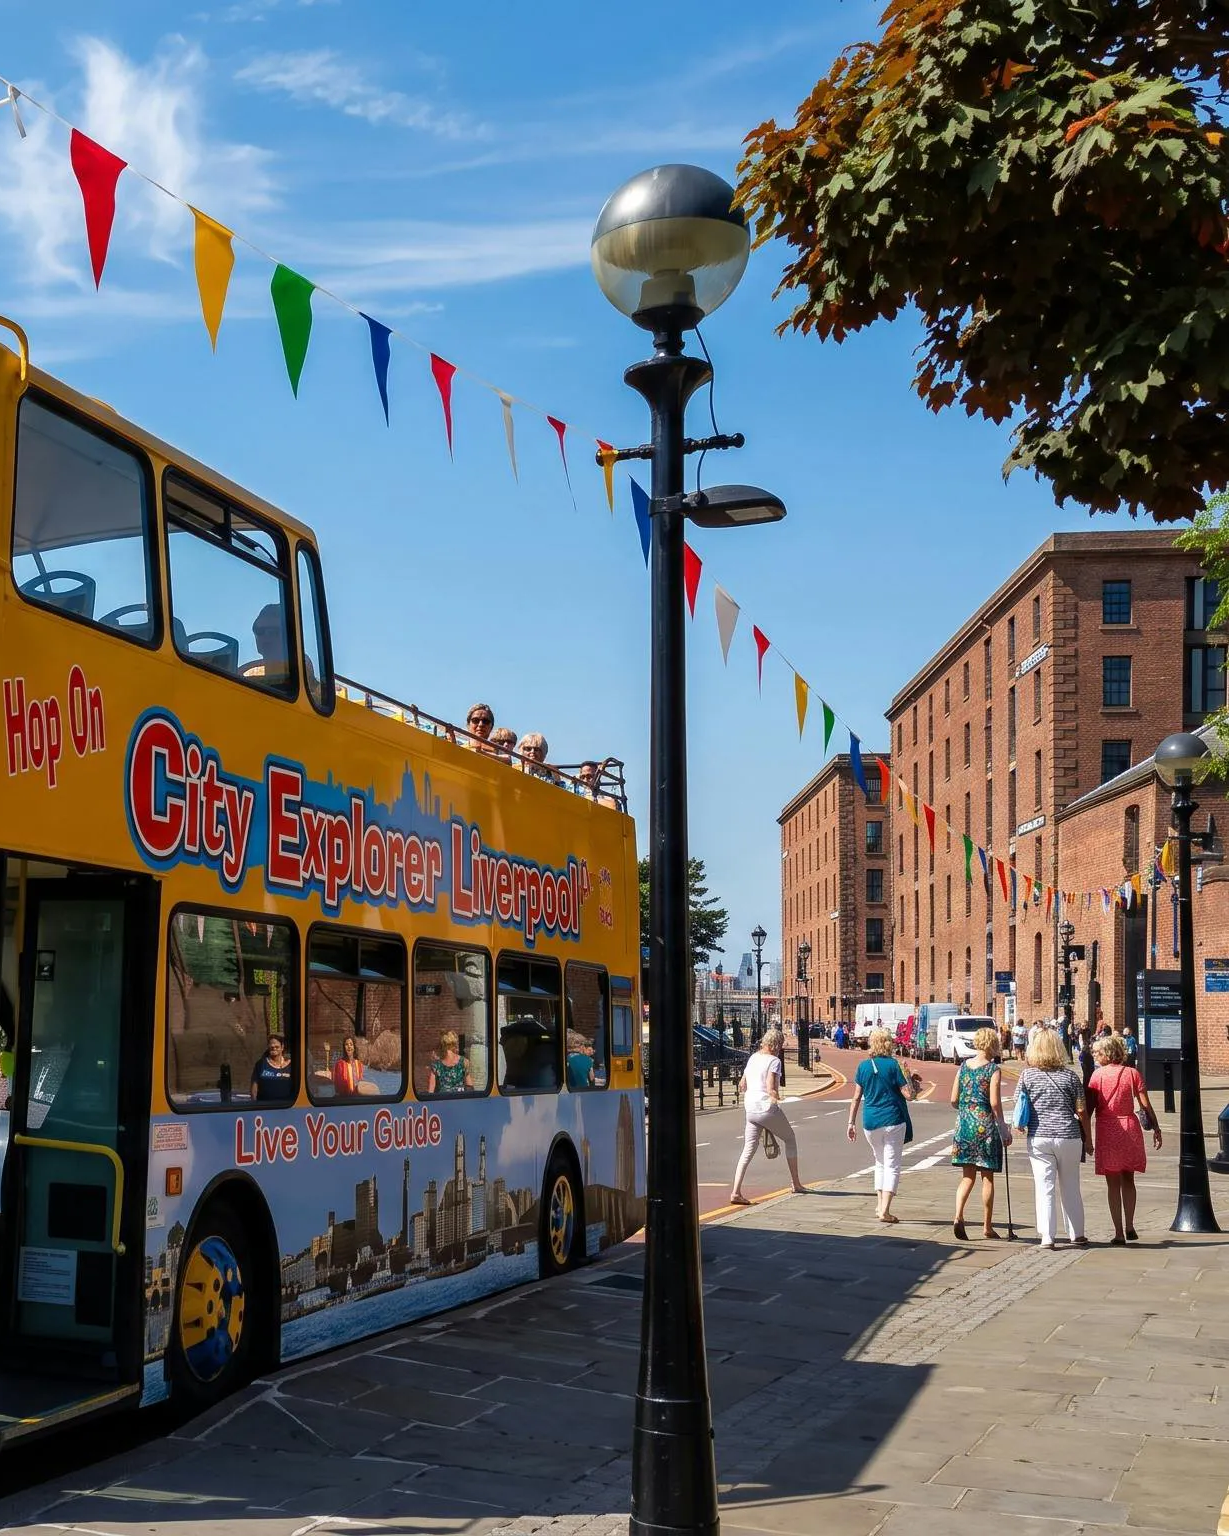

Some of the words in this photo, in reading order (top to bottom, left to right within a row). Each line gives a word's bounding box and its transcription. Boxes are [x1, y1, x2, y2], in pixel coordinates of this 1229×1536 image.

[3, 677, 62, 789] Hop
[68, 664, 106, 758] On
[130, 718, 254, 883] City
[268, 765, 443, 908] Explorer
[451, 823, 580, 940] Liverpool
[235, 1116, 299, 1167] Live
[305, 1112, 369, 1158] Your
[373, 1105, 442, 1152] Guide
